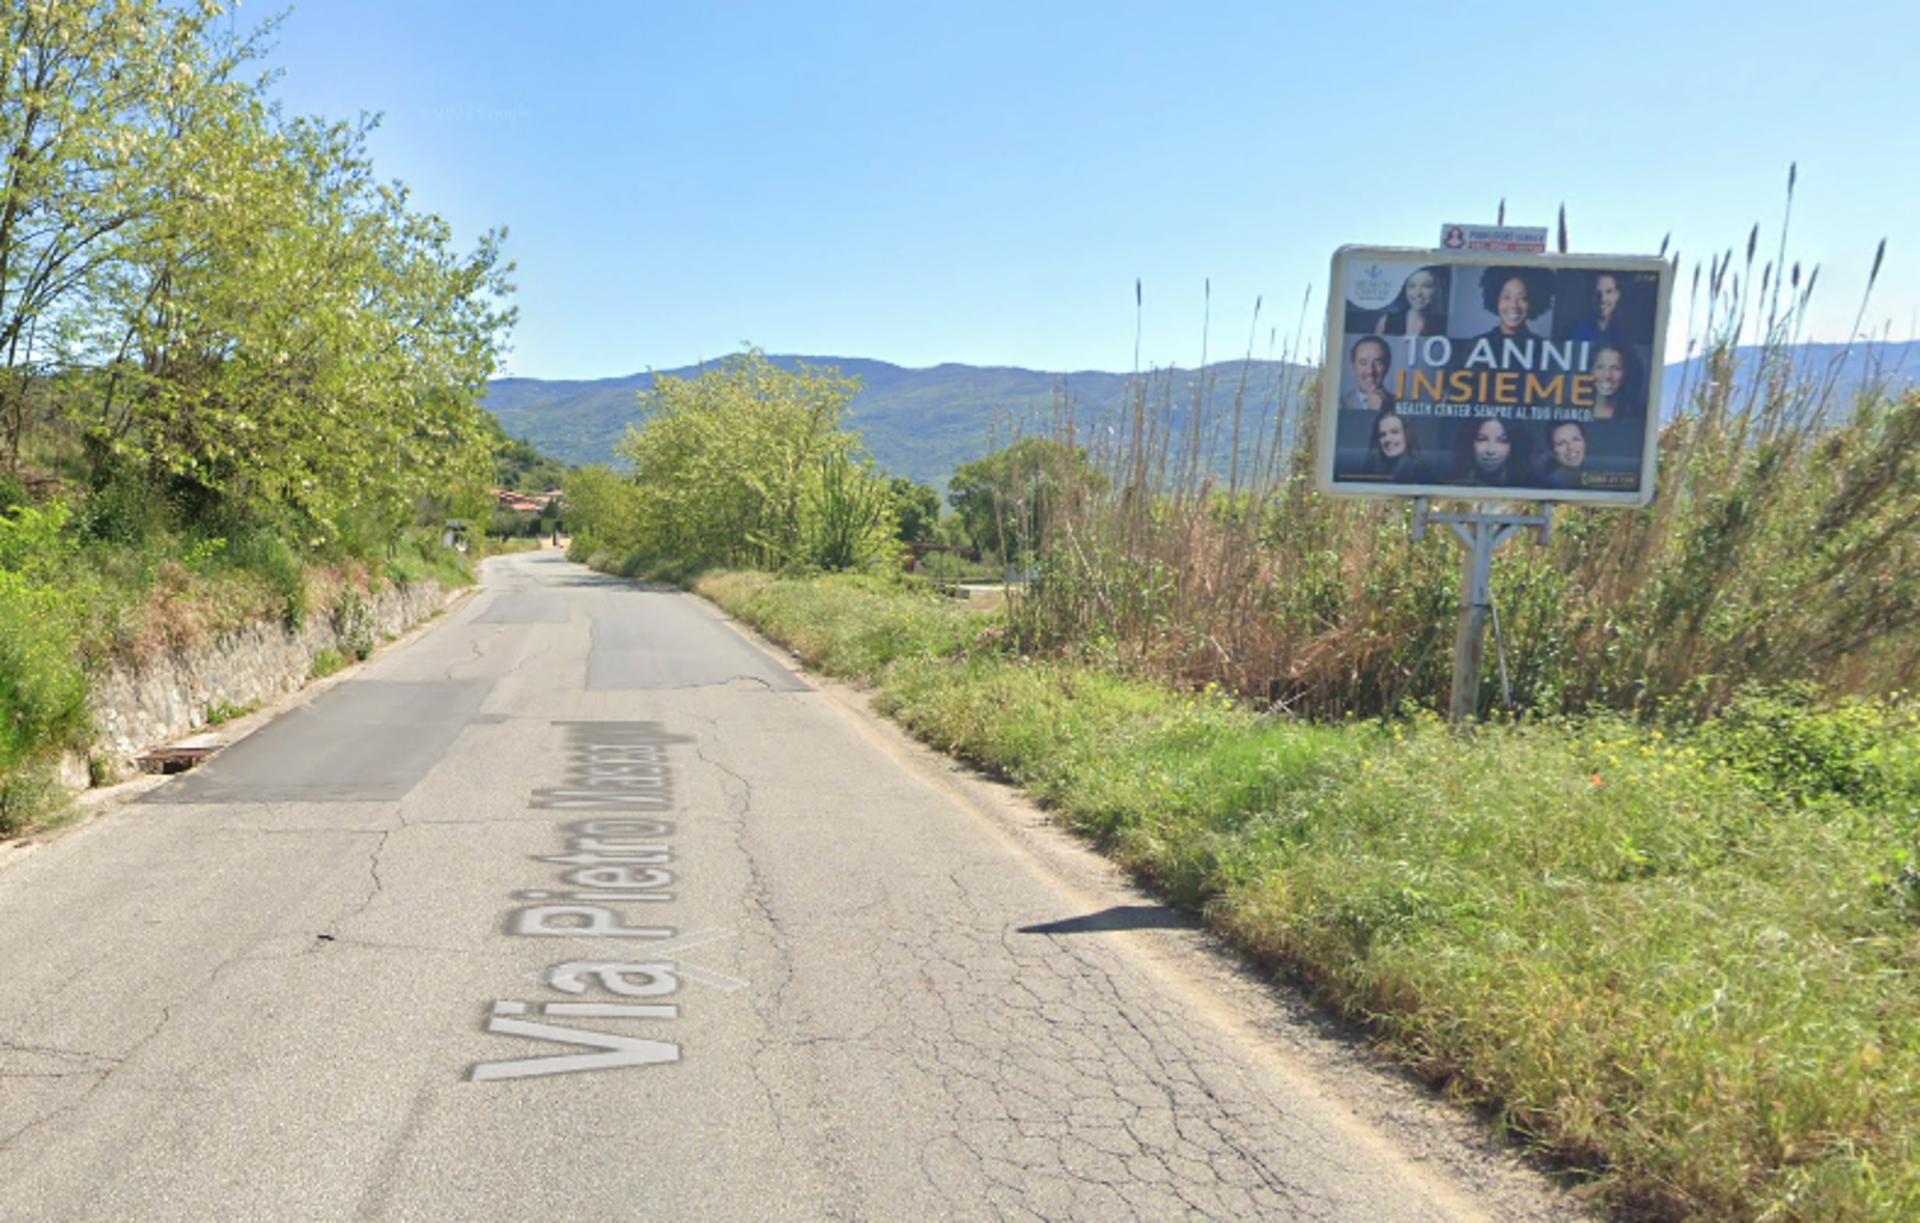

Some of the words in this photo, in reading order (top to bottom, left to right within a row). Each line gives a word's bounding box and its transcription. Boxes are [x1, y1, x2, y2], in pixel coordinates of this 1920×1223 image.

[1404, 335, 1451, 367] 10
[1464, 338, 1591, 371] ANNI
[1395, 368, 1596, 406] INSIEME
[1395, 403, 1432, 416] HEALTH
[1434, 403, 1471, 417] CENTER
[1474, 405, 1513, 419] SEMPRE
[1516, 407, 1529, 419] AL
